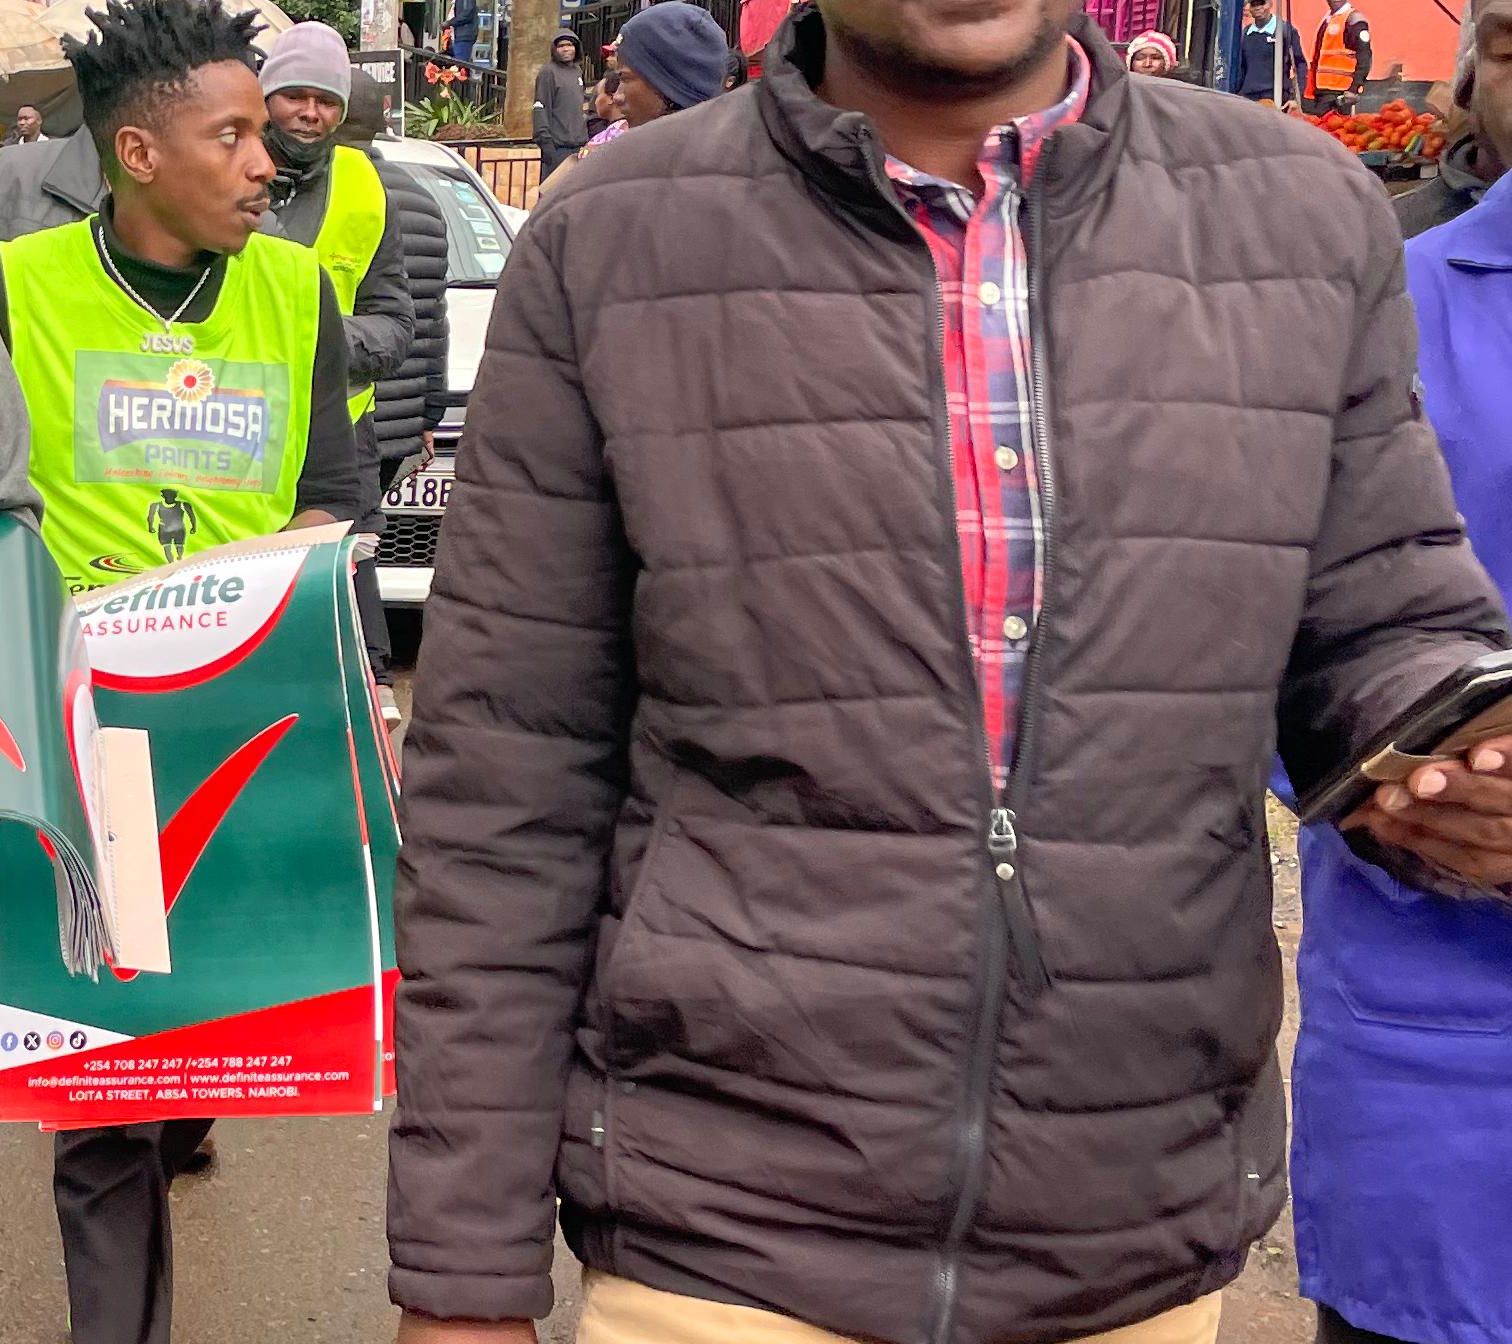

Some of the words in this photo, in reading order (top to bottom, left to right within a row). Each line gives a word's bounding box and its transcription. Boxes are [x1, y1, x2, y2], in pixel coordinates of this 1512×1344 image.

[139, 332, 195, 355] JESUS
[108, 393, 263, 443] HERMOSA
[145, 443, 232, 471] PAINTS
[82, 611, 228, 637] ASSURANCE
[83, 1060, 111, 1071] +254
[113, 1059, 135, 1070] 708
[137, 1058, 159, 1069] 247
[161, 1057, 183, 1069] 247
[222, 1057, 243, 1068] 788
[246, 1056, 268, 1067] 247
[270, 1056, 293, 1067] 247
[27, 1074, 181, 1088] info@definiteassurance.com
[190, 1071, 350, 1084] www.definiteassurance.com
[69, 1090, 104, 1101] LOITA
[105, 1089, 153, 1101] STREET,
[155, 1088, 188, 1100] ABSA
[191, 1087, 245, 1099] TOWERS,
